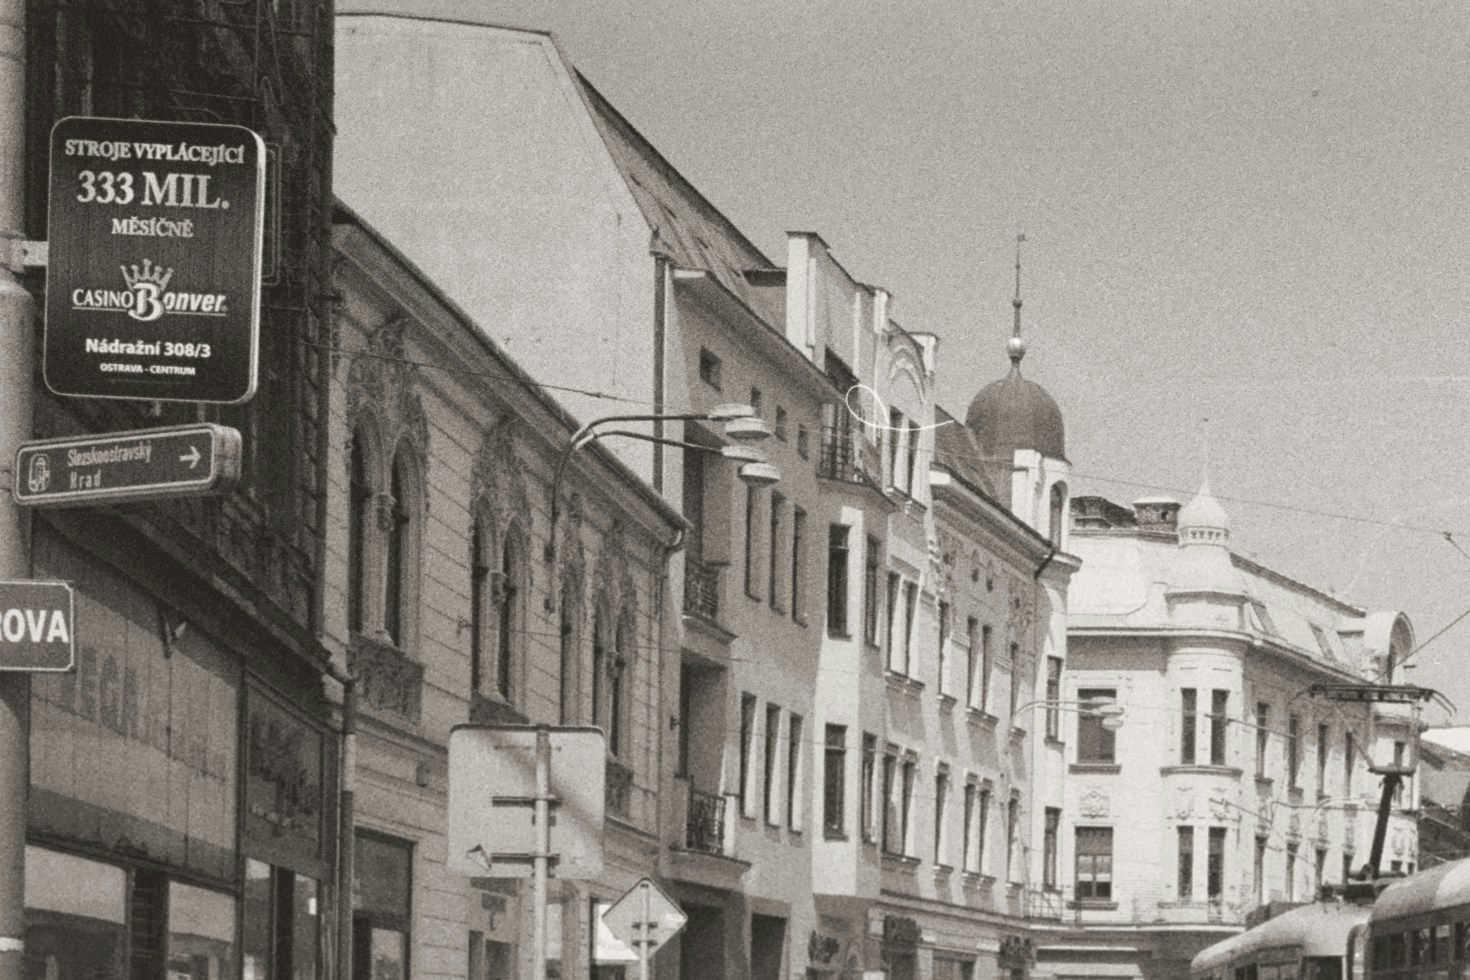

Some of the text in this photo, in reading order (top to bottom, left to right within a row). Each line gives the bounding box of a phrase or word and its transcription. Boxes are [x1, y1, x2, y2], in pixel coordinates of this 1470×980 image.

[65, 139, 245, 166] STROJE VYPLÁCEJÍCÍ
[77, 170, 230, 209] 333 MIL.
[111, 216, 194, 238] MĚSÍČNĚ
[72, 282, 226, 321] CASINO Bonver
[85, 338, 211, 358] Nádražní 308/3
[99, 363, 143, 373] OSTRAVA
[149, 364, 196, 375] CENTRUM
[67, 440, 152, 467] Slezskoostravský
[69, 468, 102, 490] Hrad
[0, 608, 69, 643] OVA
